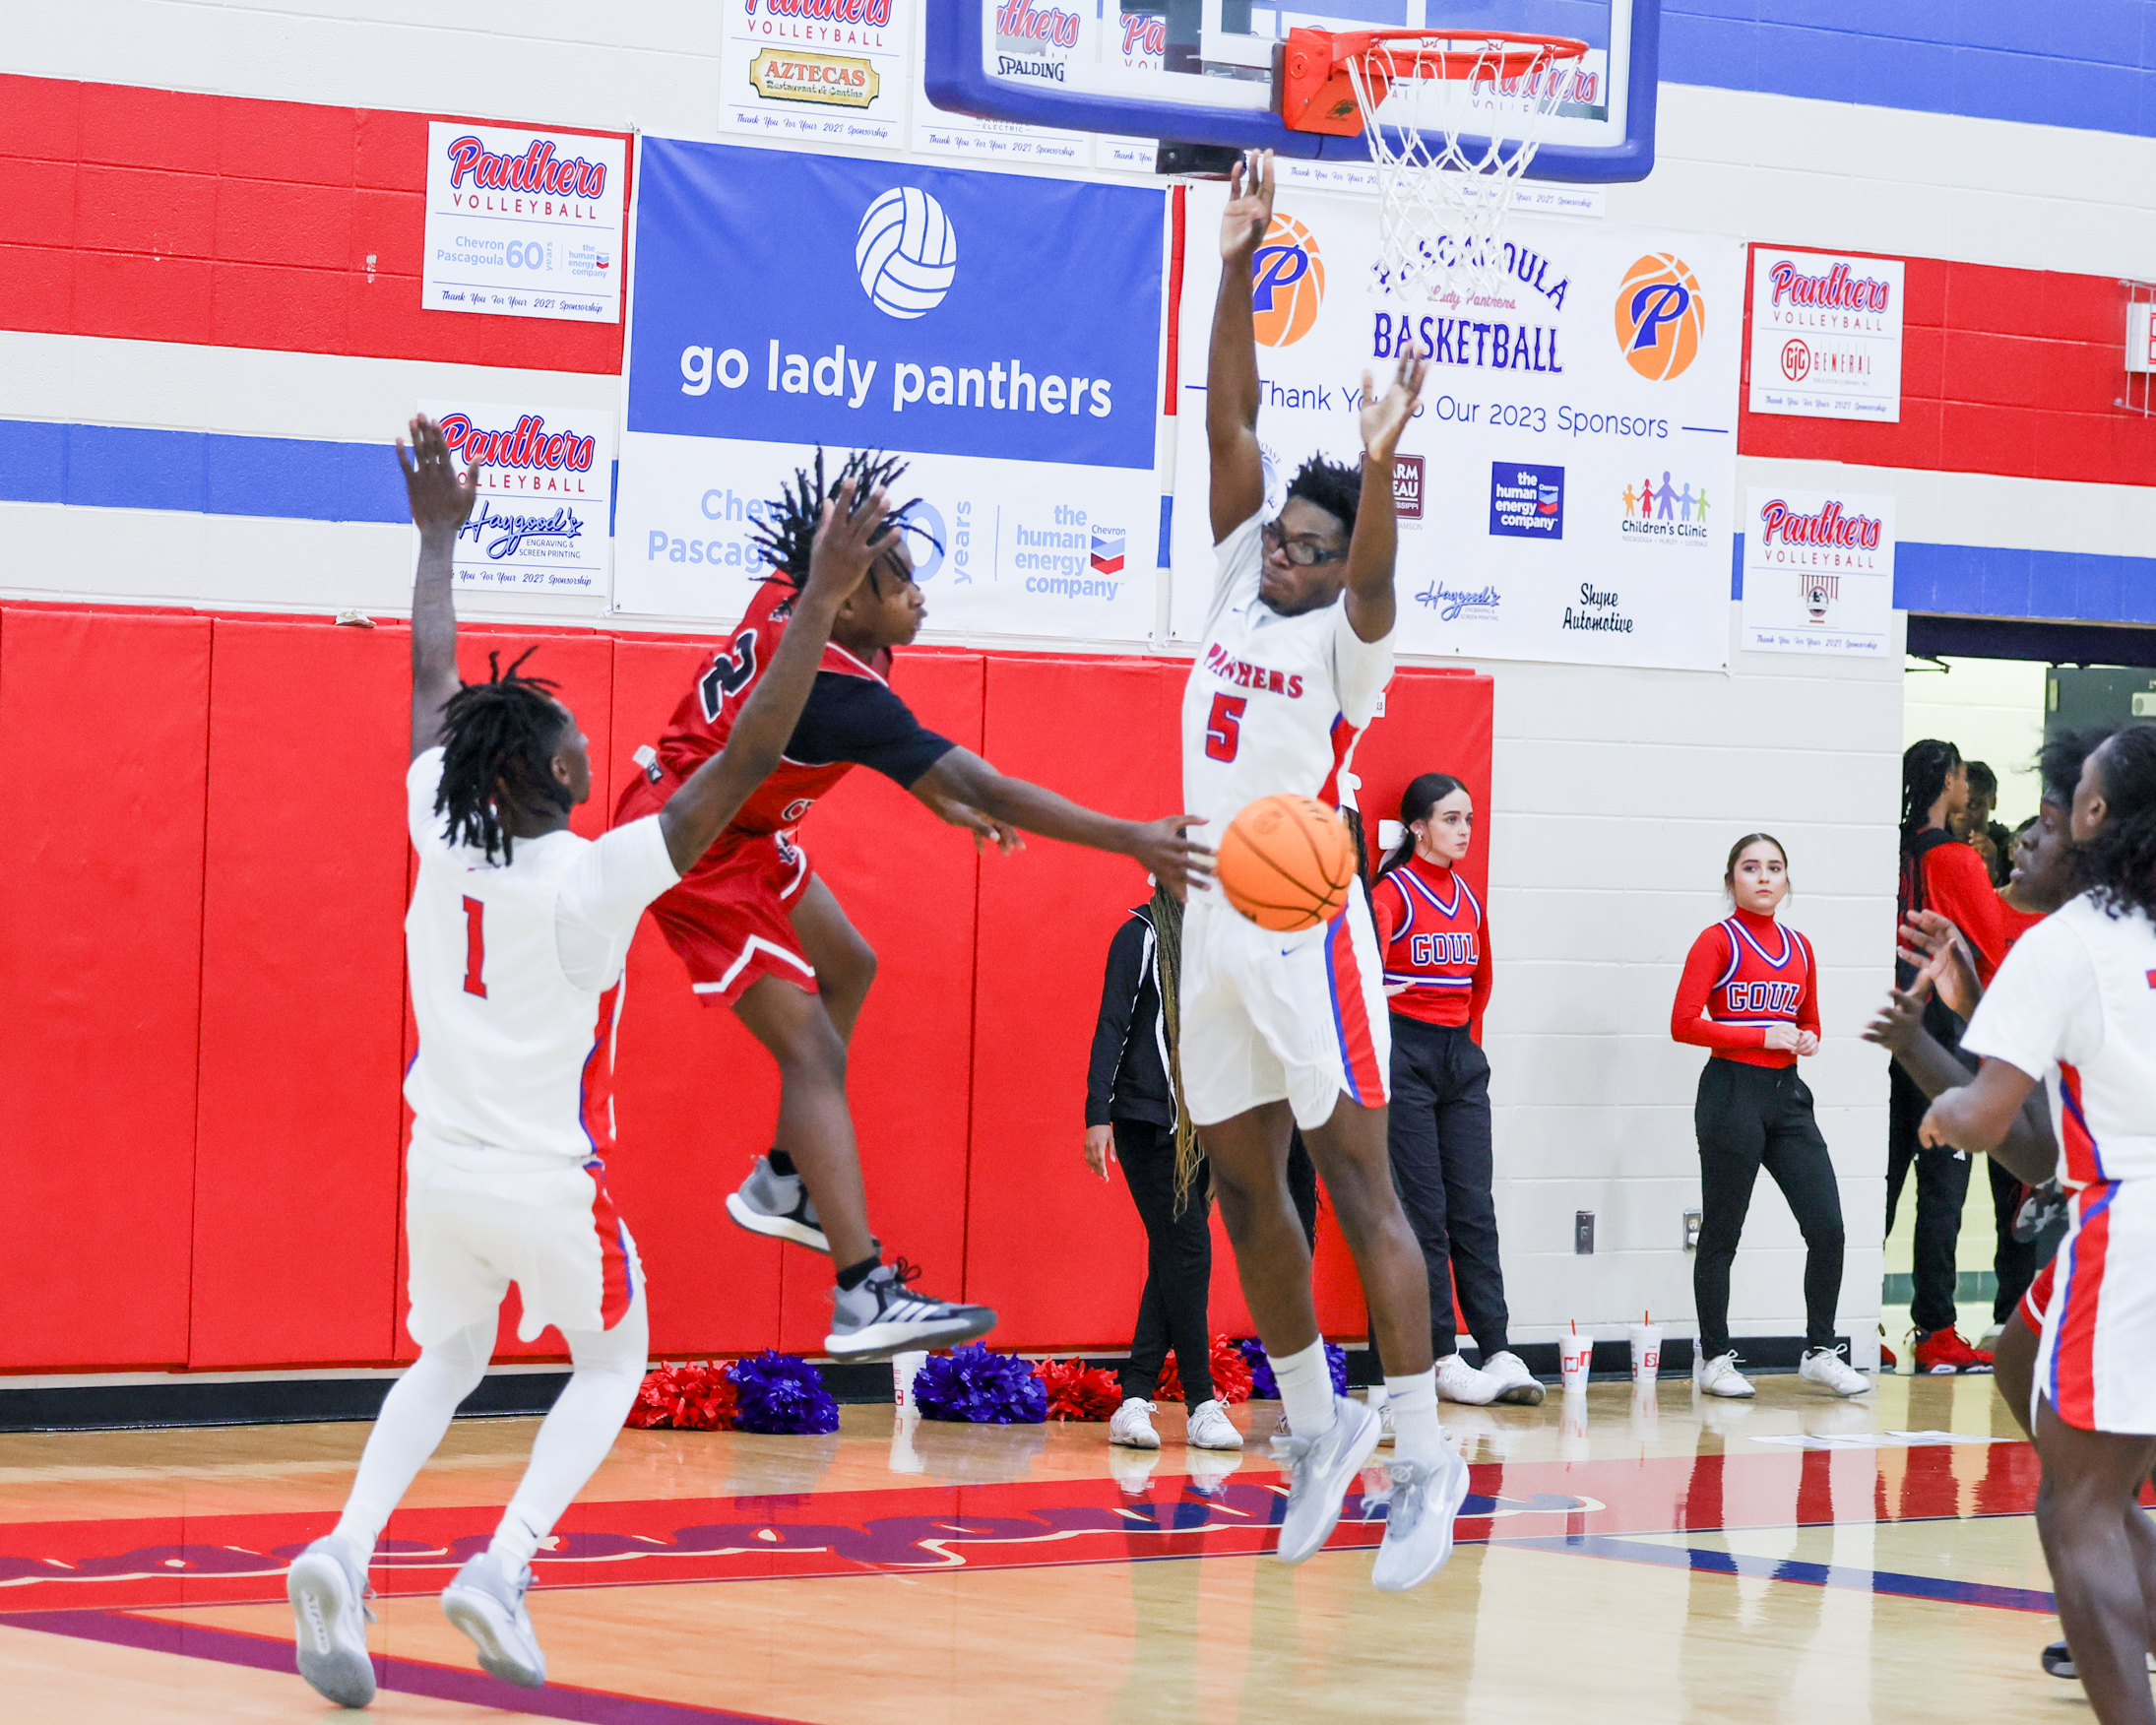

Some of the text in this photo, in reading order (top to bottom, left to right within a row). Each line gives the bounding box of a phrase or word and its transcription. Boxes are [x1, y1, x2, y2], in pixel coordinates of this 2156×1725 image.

[747, 19, 883, 47] VOLLEYBALL
[764, 60, 866, 88] AZTECAS
[997, 55, 1065, 83] SPALDING
[736, 113, 888, 139] Thank You For Your 2023 Sponsorship
[983, 123, 1024, 133] ELECTRIC
[928, 134, 1075, 158] Thank You For Your 2023 Sponsorship
[1113, 150, 1153, 164] Thank You
[448, 135, 606, 199] Panthers
[1291, 166, 1310, 177] Thank
[1314, 169, 1328, 181] You
[1332, 171, 1344, 181] For
[1347, 173, 1363, 185] Your
[453, 193, 597, 220] VOLLEYBALL
[1516, 192, 1532, 203] Your
[1557, 196, 1592, 209] Sponsorship
[455, 235, 504, 250] Chevron
[582, 243, 596, 252] the
[437, 249, 504, 267] Pascagoula
[505, 240, 544, 271] 60
[568, 250, 595, 260] human
[568, 260, 596, 269] energy
[571, 268, 607, 279] company
[1769, 261, 1890, 313] Panthers
[441, 290, 603, 314] Thank You For Your 2023 Sponsorship
[1631, 282, 1691, 352] P
[1774, 311, 1882, 331] VOLLEYBALL
[1372, 311, 1563, 373] BASKETBALL
[1814, 351, 1871, 375] GENERAL
[680, 339, 1113, 418] go lady panthers
[1259, 380, 1332, 412] Thank
[1436, 395, 1481, 423] Our
[1490, 402, 1548, 433] 2023
[1557, 406, 1669, 439] Sponsors
[1765, 396, 1783, 405] Thank
[1787, 397, 1799, 408] You
[1815, 399, 1830, 410] Your
[439, 413, 596, 473] Panthers
[457, 473, 585, 492] OLEYBALL
[1517, 472, 1538, 486] the
[1496, 483, 1537, 500] human
[701, 488, 792, 524] Chev
[1053, 504, 1088, 527] the
[1495, 500, 1537, 516] energy
[459, 500, 584, 560] Haygood's
[1091, 524, 1126, 536] Chevron
[1501, 514, 1554, 531] company
[1621, 520, 1707, 538] Children's Clinic
[1761, 499, 1882, 550] Panthers
[526, 539, 568, 548] ENGRAVING
[954, 499, 972, 585] years
[1016, 525, 1087, 549] human
[519, 548, 581, 559] SCREEN PRINTING
[1015, 550, 1087, 576] energy
[1764, 549, 1873, 568] VOLLEYBALL
[459, 570, 476, 583] You
[480, 571, 493, 582] For
[496, 572, 517, 584] Your
[522, 573, 544, 584] 2023
[548, 575, 592, 588] Sponsorship
[1026, 574, 1119, 601] company
[1415, 579, 1501, 621] Haygood's
[1580, 583, 1619, 610] Shyne
[1562, 607, 1634, 633] Automotive
[1756, 634, 1774, 644] Thank
[1778, 636, 1790, 646] You
[1807, 638, 1821, 648] Your
[699, 628, 758, 724] 2
[1205, 691, 1247, 763] 5
[462, 893, 488, 1000] 1
[1411, 932, 1479, 966] GOUL
[1727, 981, 1801, 1015] GOUL
